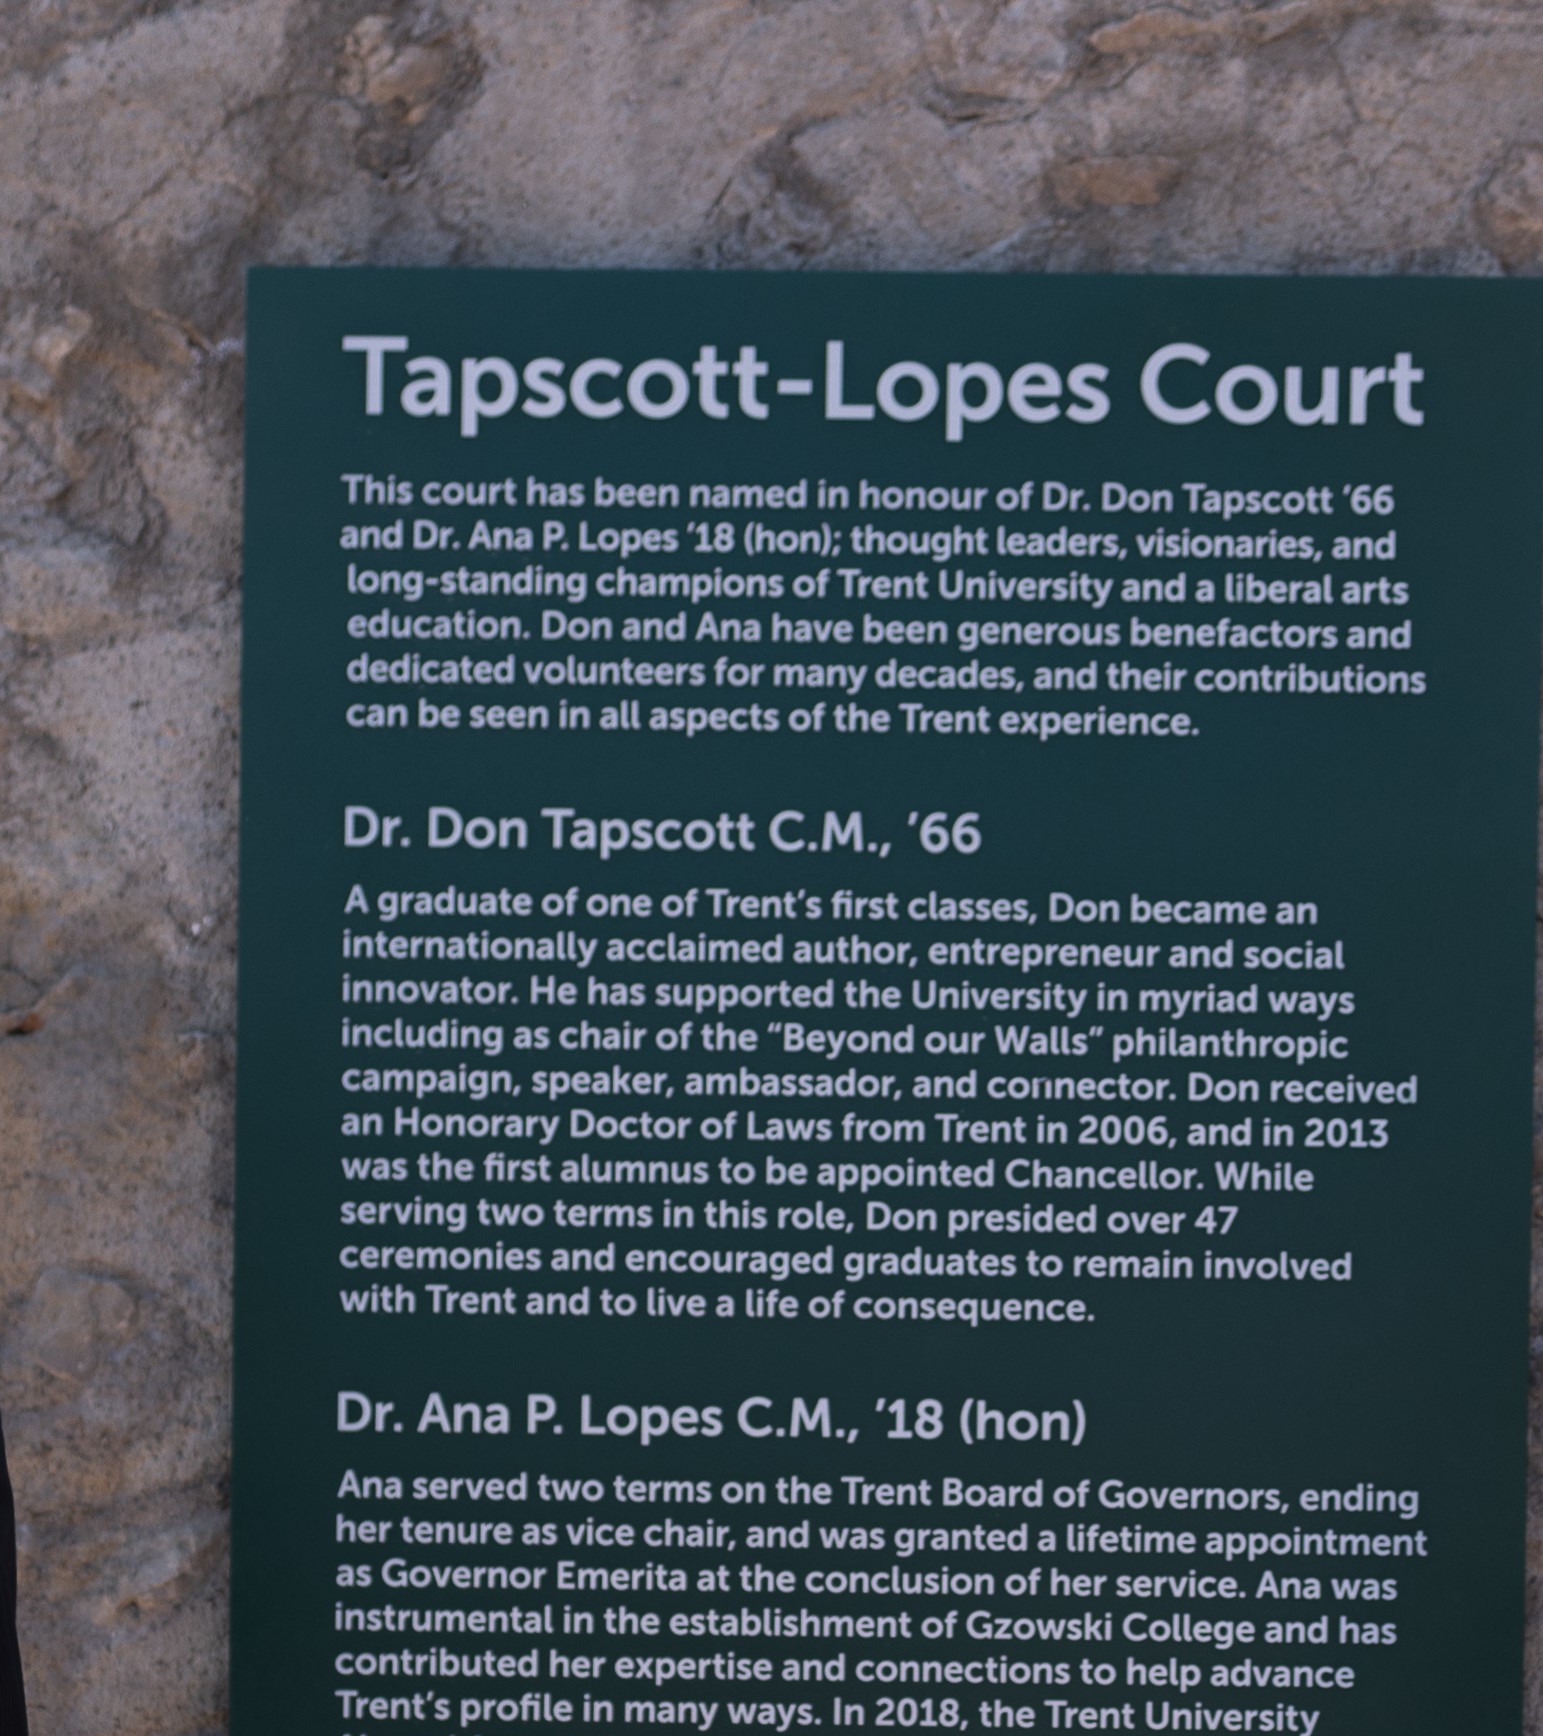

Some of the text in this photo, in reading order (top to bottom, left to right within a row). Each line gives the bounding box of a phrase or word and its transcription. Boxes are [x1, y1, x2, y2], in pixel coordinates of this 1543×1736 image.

[343, 336, 1423, 441] Tapscott-Lopes Court
[341, 474, 412, 504] This
[422, 479, 516, 505] court
[527, 477, 584, 506] has
[595, 477, 679, 507] been
[690, 479, 807, 508] named
[818, 480, 848, 508] in
[860, 480, 987, 510] honour
[996, 481, 1033, 510] of
[1043, 482, 1090, 511] Dr.
[1102, 482, 1172, 512] Don
[1182, 483, 1332, 519] Tapscott
[340, 520, 402, 549] and
[414, 520, 459, 549] Dr.
[468, 520, 532, 550] Ana
[543, 521, 568, 550] P.
[579, 522, 678, 558] Lopes
[744, 522, 841, 556] (hon);
[851, 525, 988, 561] thought
[997, 526, 1127, 559] leaders,
[1136, 528, 1322, 561] visionaries,
[1332, 531, 1395, 559] and
[348, 564, 1408, 608] long-standing champions of Trent University and a liberal arts
[347, 653, 1426, 694] dedicated volunteers for many decades, and their contributions
[347, 698, 1198, 741] can be seen in all aspects of the Trent experience.
[345, 806, 410, 847] Dr.
[429, 807, 527, 848] Don
[541, 808, 754, 859] Tapscott
[770, 810, 890, 857] C.M.,
[343, 929, 1344, 972] internationally acclaimed author, entrepreneur and social
[342, 1018, 503, 1055] including
[514, 1027, 549, 1049] as
[559, 1021, 647, 1049] chair
[656, 1022, 692, 1050] of
[701, 1022, 758, 1051] the
[925, 1032, 985, 1054] our
[1113, 1027, 1348, 1065] philanthropic
[342, 1064, 1417, 1103] campaign, speaker, ambassador, and connector. Don received
[342, 1107, 1388, 1148] an Honorary Doctor of Laws from Trent in 2006, and in 2013
[340, 1241, 1351, 1281] ceremonies and encouraged graduates to remain involved
[338, 1392, 402, 1432] Dr.
[418, 1393, 509, 1434] Ana
[528, 1394, 562, 1434] P.
[581, 1395, 722, 1445] Lopes
[738, 1397, 858, 1443] C.M.,
[960, 1398, 1085, 1445] (hon)
[336, 1603, 1396, 1649] instrumental in the establishment of Gzowski College and has
[335, 1648, 1354, 1693] contributed her expertise and connections to help advance
[461, 1693, 573, 1727] profile
[584, 1694, 613, 1722] in
[625, 1701, 718, 1731] many
[727, 1703, 821, 1732] ways.
[834, 1697, 864, 1725] In
[875, 1697, 968, 1730] 2018,
[979, 1699, 1035, 1728] the
[1044, 1700, 1134, 1729] Trent
